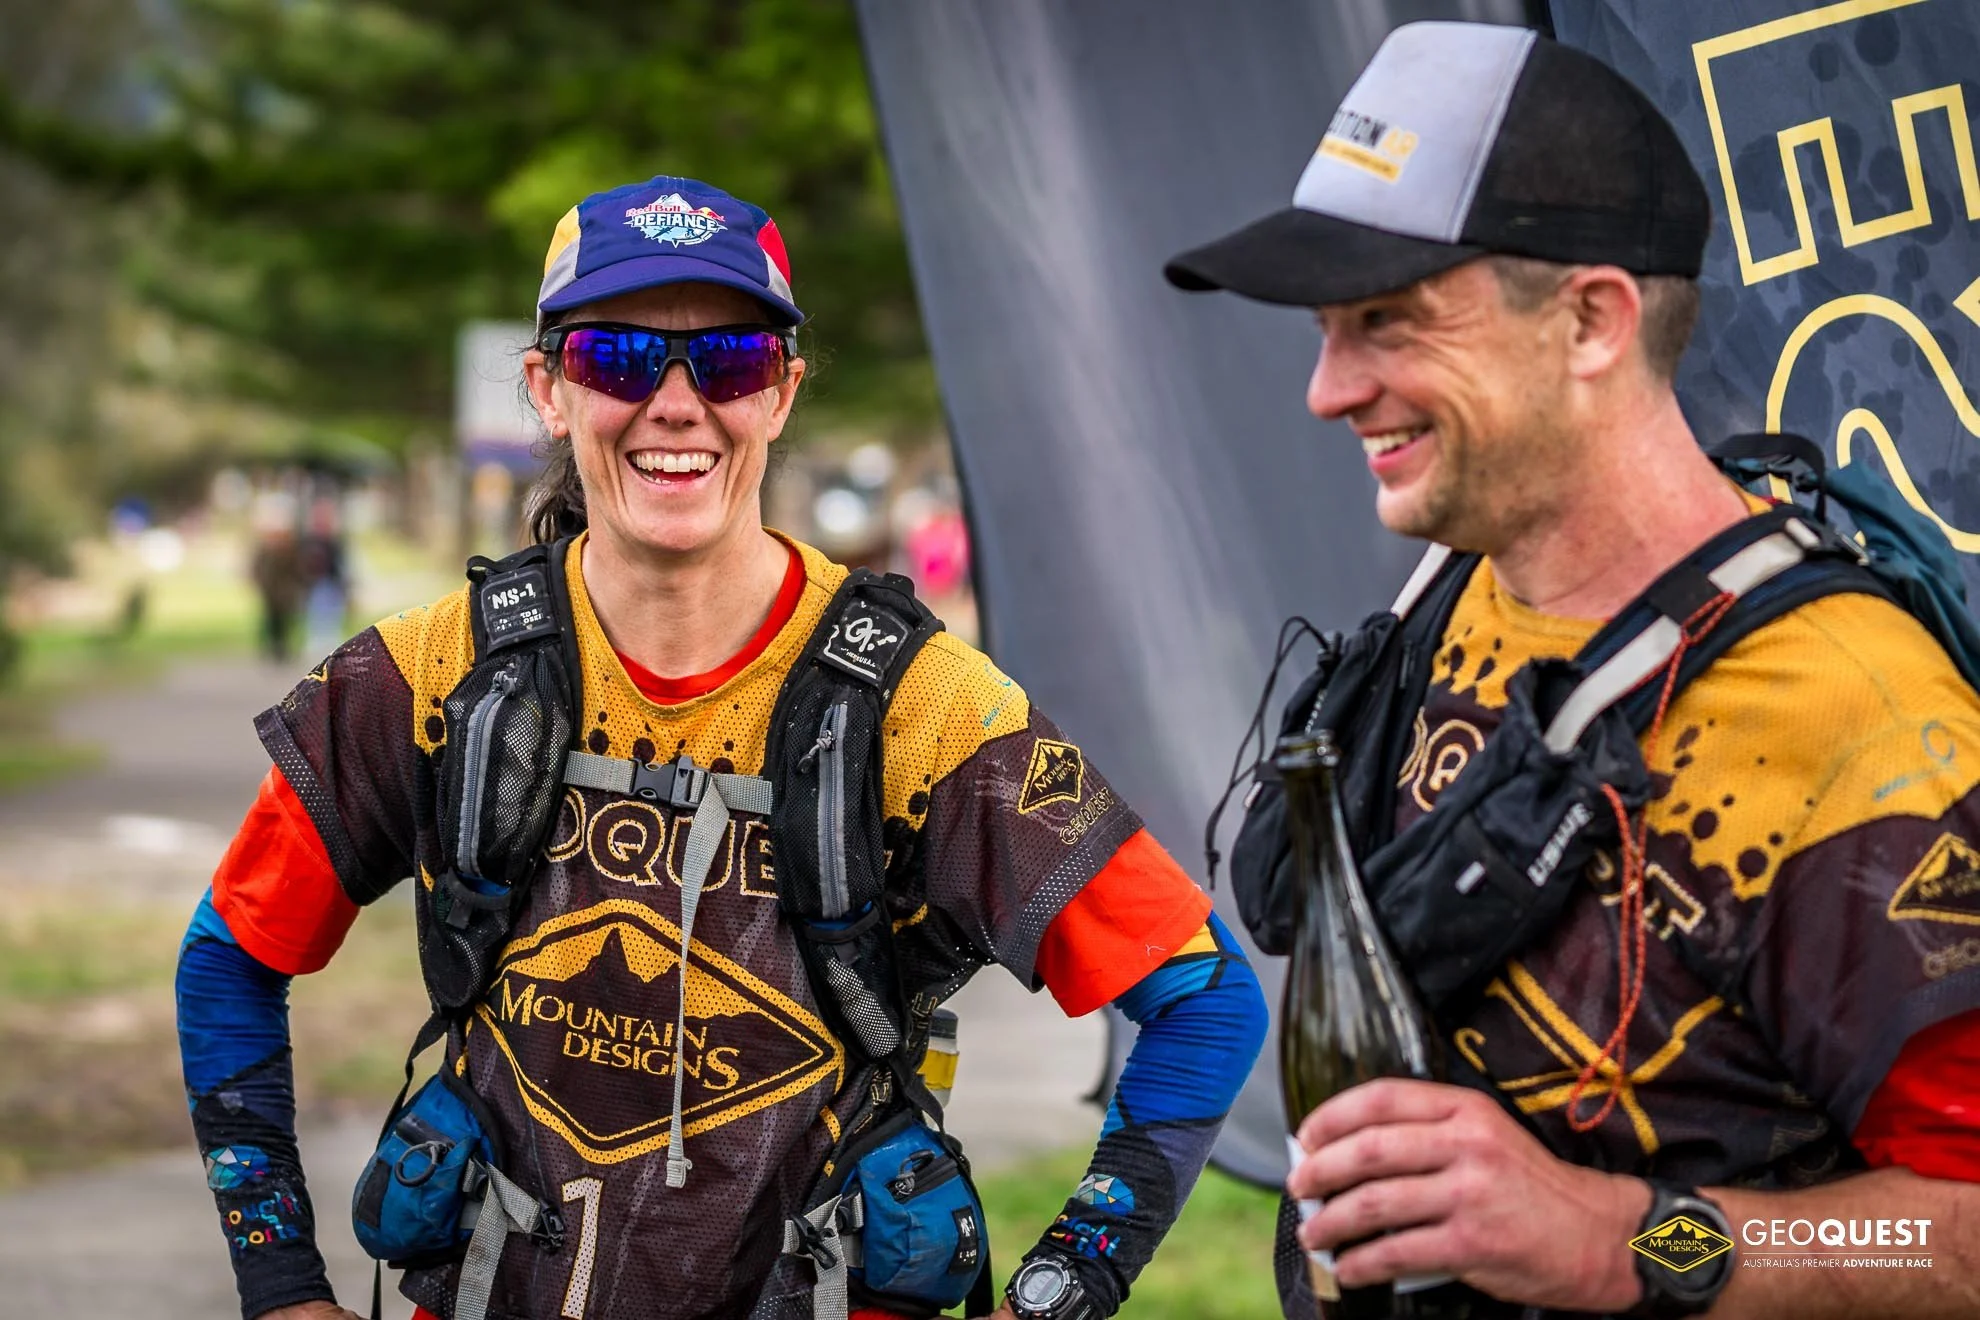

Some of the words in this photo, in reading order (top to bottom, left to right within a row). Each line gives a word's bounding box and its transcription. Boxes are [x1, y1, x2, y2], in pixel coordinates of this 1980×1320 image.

[625, 204, 652, 217] Red
[654, 204, 681, 212] Bull
[633, 212, 718, 232] DEFIANCE
[490, 583, 535, 610] MS-1
[501, 978, 707, 1051] MOUNTAIN
[562, 1031, 741, 1091] DESIGNS
[561, 1176, 604, 1320] 1
